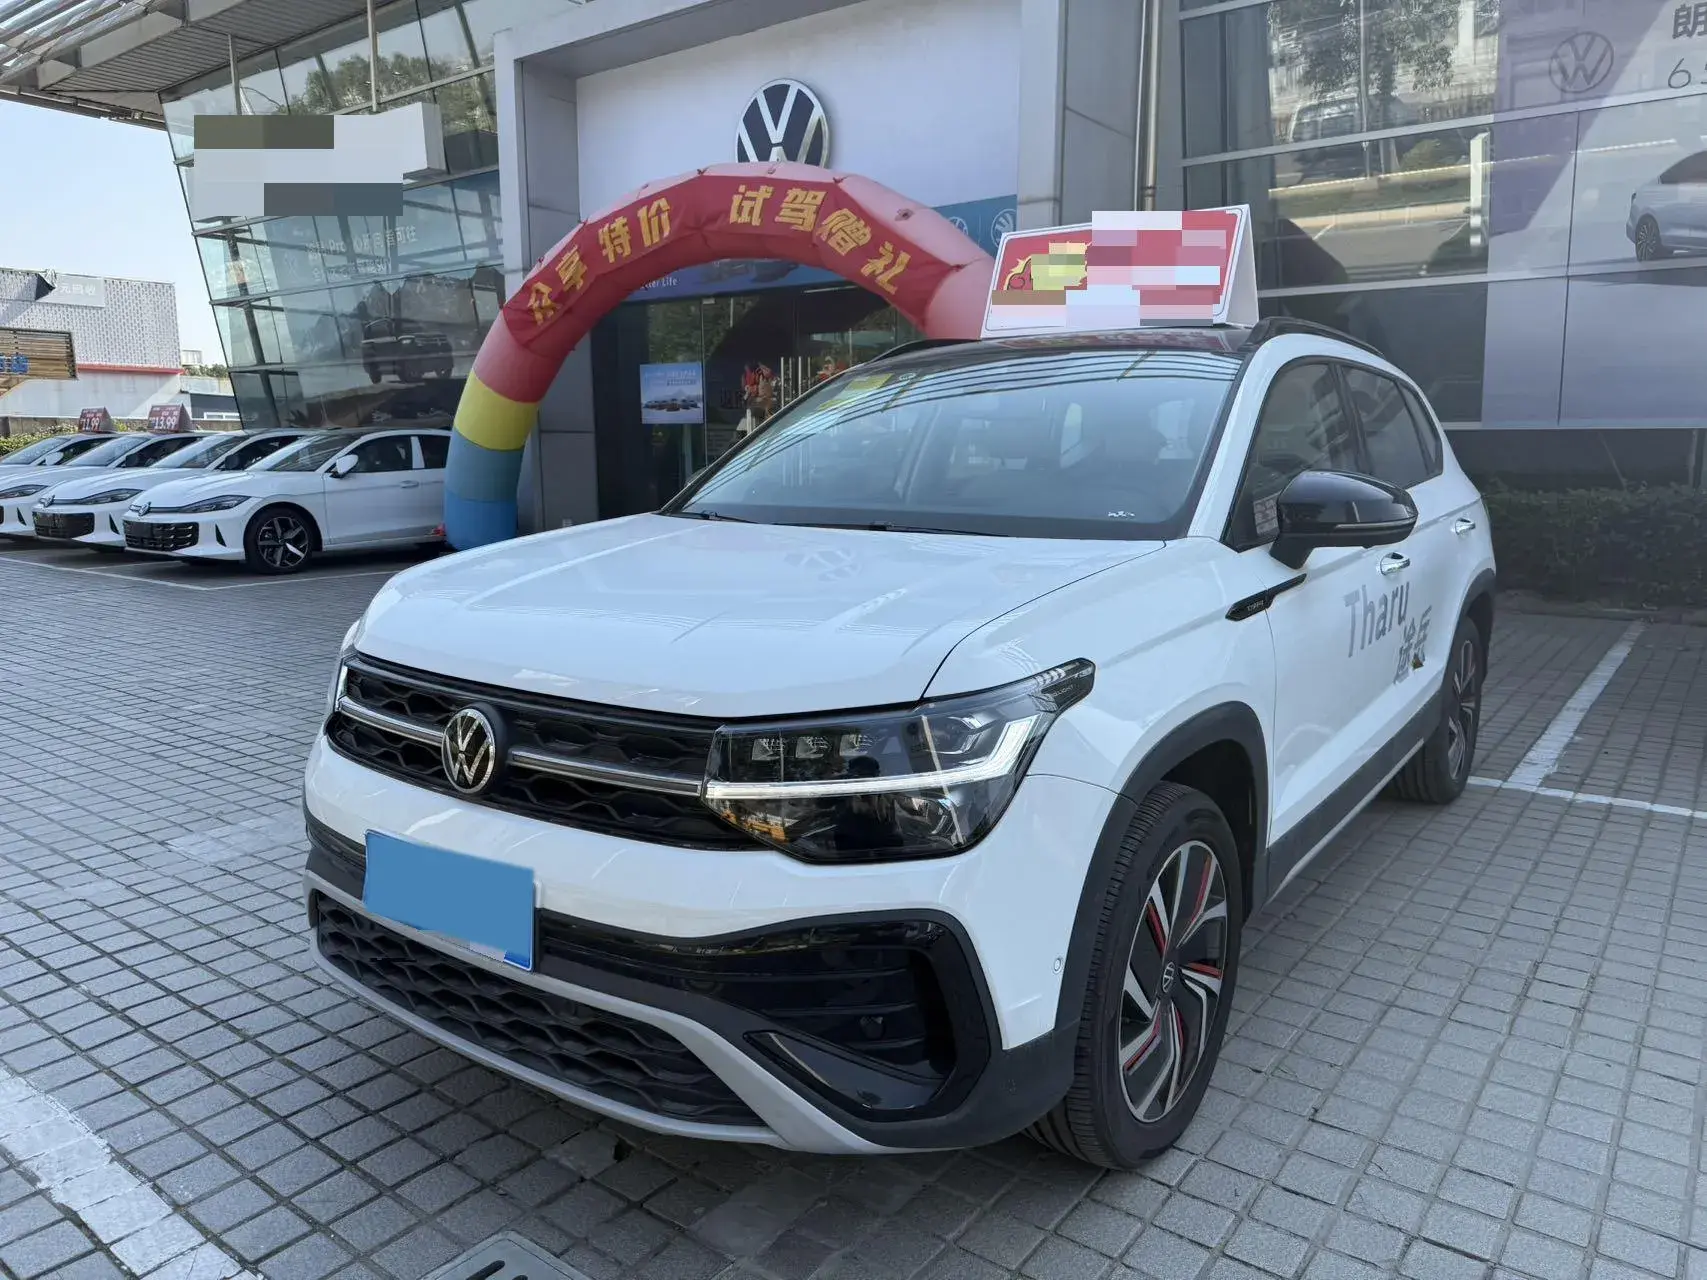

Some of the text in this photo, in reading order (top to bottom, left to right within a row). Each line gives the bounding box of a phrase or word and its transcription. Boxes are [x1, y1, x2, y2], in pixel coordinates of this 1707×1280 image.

[729, 184, 911, 295] 试驾赠礼
[1343, 581, 1410, 658] Tharu
